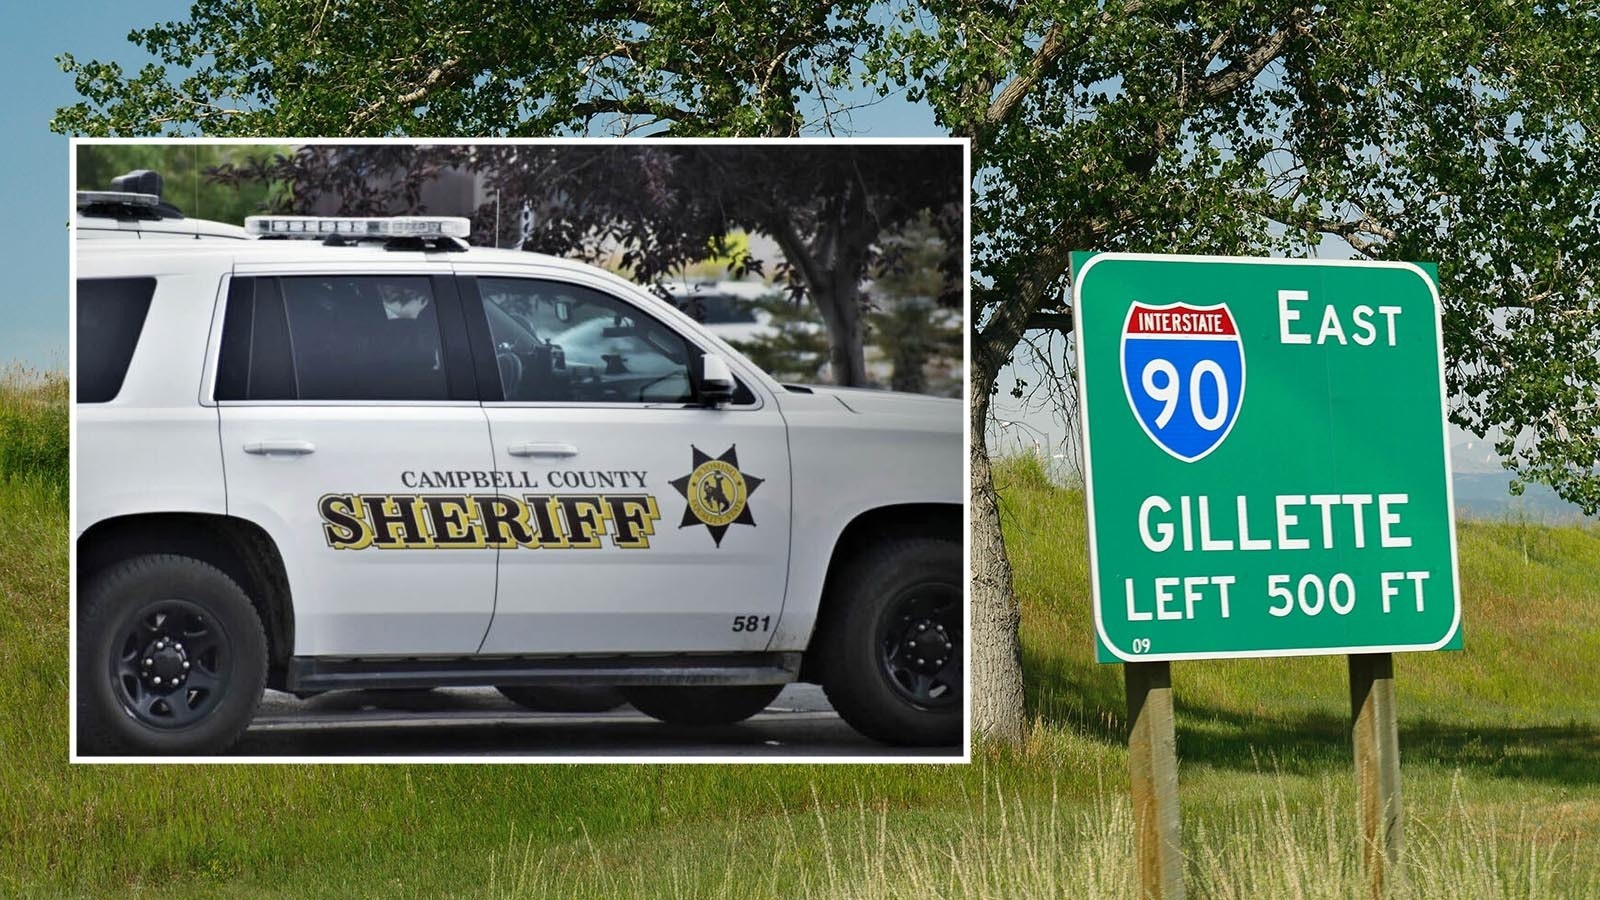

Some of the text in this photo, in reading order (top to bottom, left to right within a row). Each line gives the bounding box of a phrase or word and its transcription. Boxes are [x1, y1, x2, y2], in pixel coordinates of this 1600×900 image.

[1138, 312, 1224, 333] INTERSTATE
[1141, 358, 1229, 431] 90
[401, 470, 648, 488] CAMPBELL COUNTY
[317, 493, 661, 550] SHERIFF
[1138, 493, 1412, 552] GILLETTE
[1125, 571, 1430, 622] LEFT 500 FT
[732, 616, 770, 632] 581
[1132, 638, 1151, 654] 09
